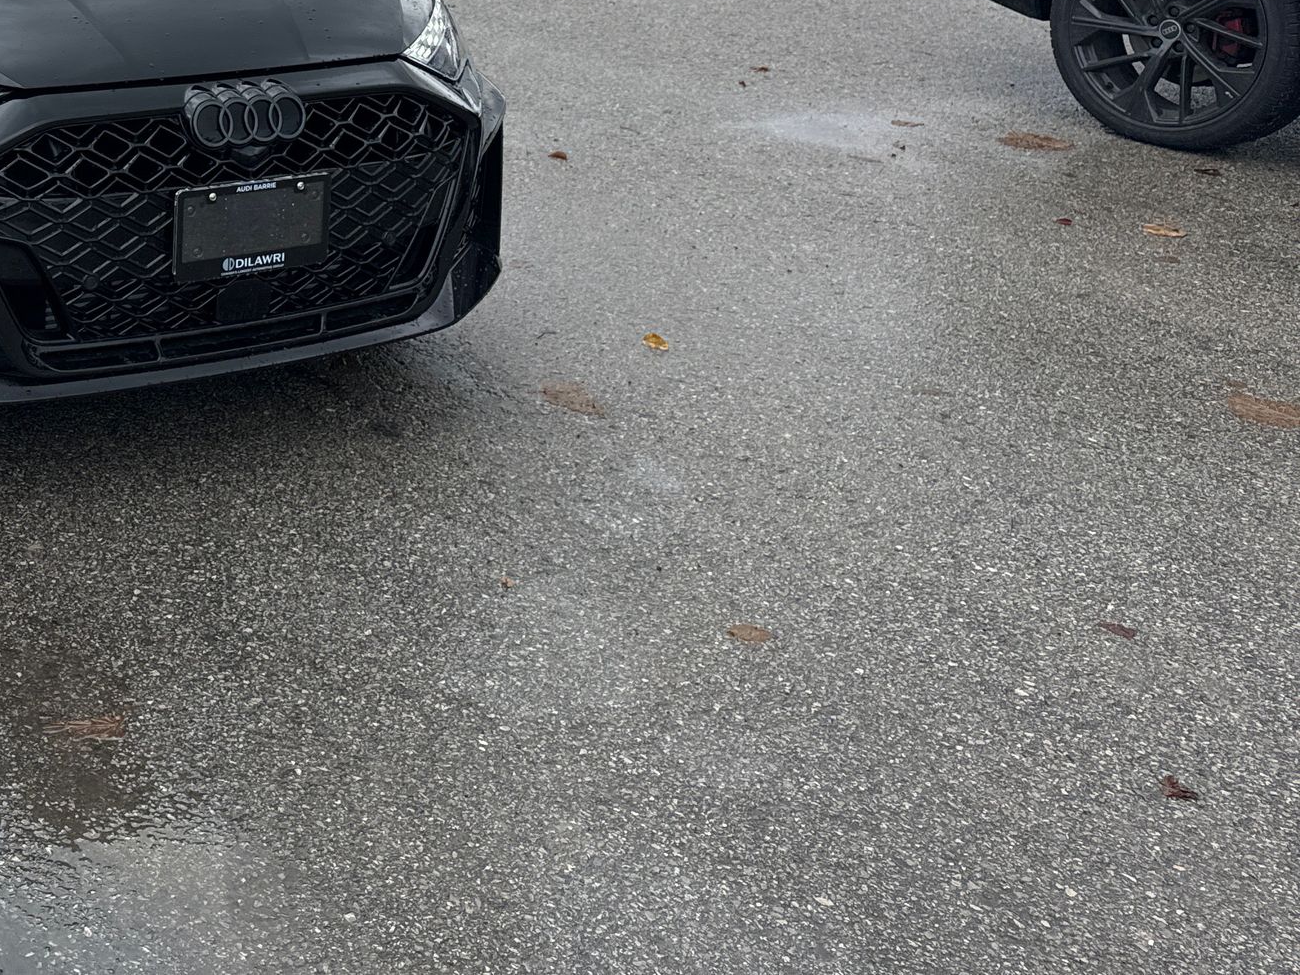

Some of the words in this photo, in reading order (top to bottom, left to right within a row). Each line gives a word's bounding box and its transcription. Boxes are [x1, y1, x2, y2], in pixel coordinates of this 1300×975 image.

[236, 185, 253, 193] AUDI
[253, 181, 277, 191] BARRIE
[235, 252, 285, 269] DILAWRI
